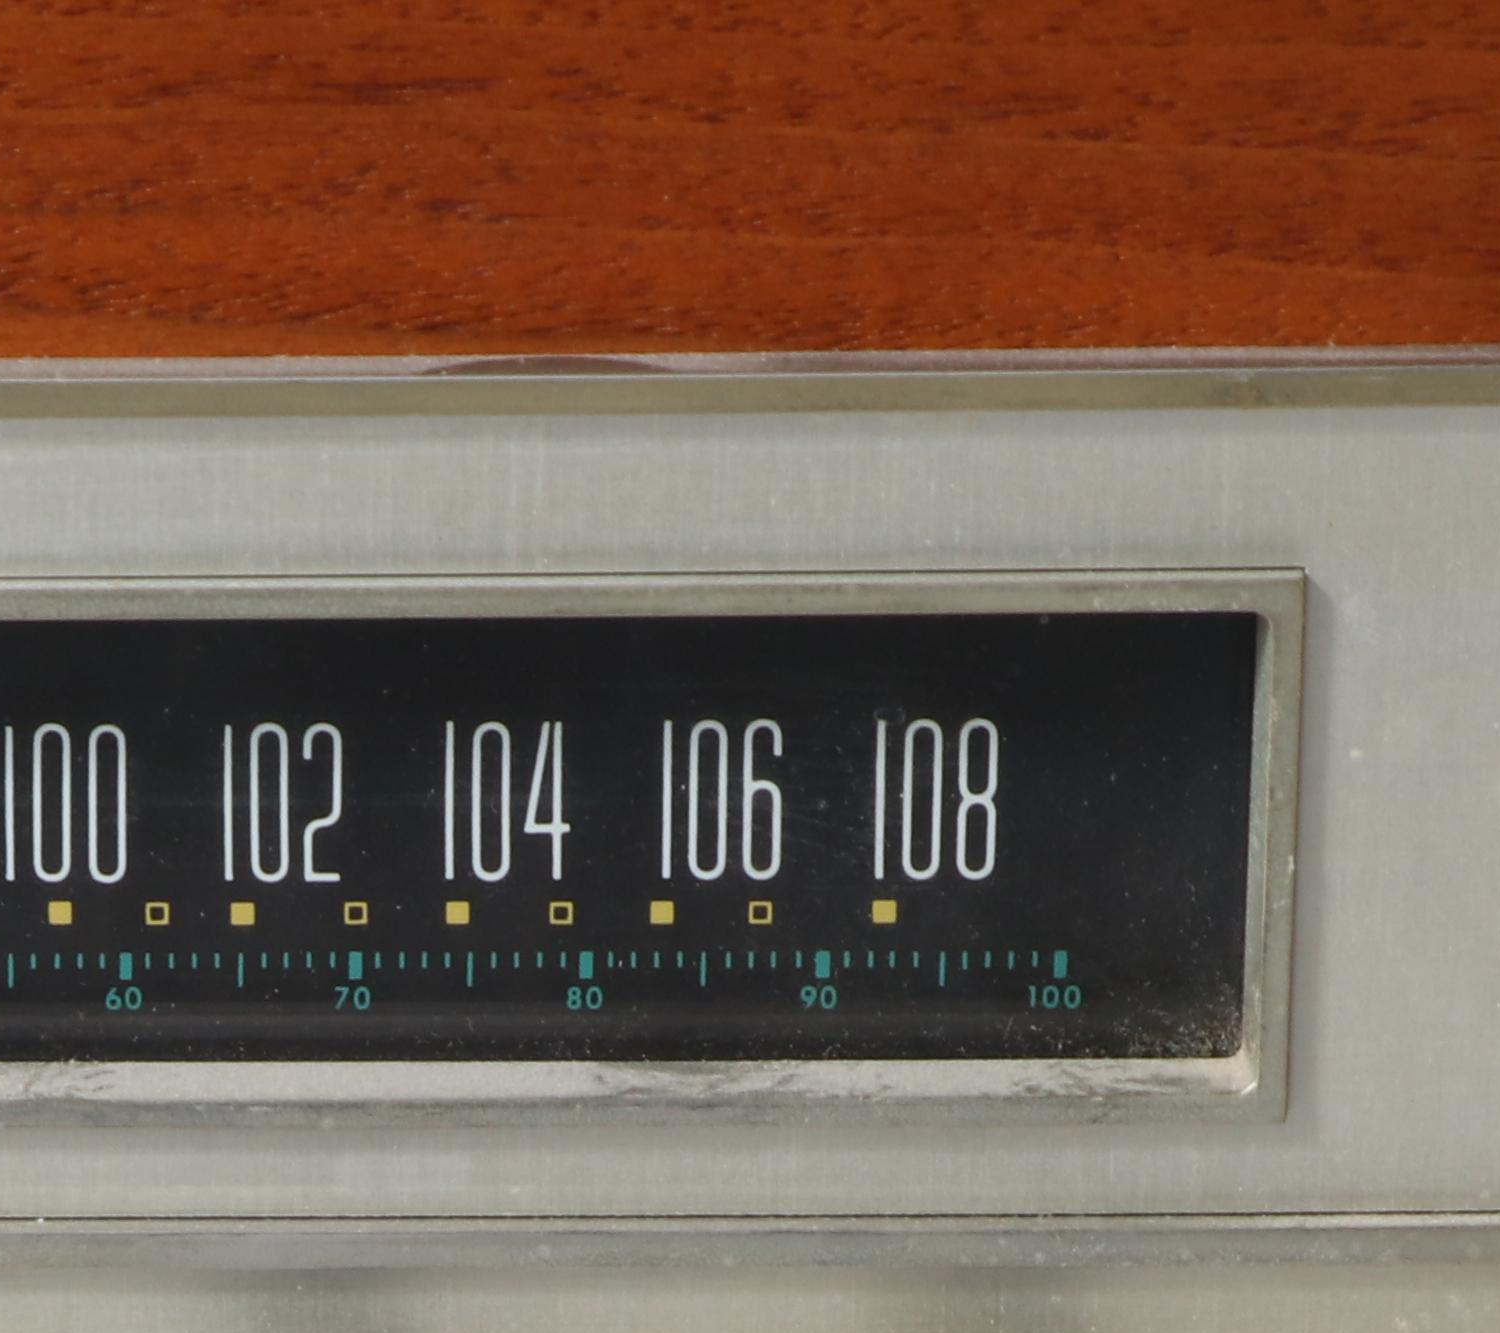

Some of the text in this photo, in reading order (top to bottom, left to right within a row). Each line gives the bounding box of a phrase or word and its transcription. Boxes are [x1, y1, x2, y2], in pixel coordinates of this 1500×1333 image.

[4, 723, 127, 884] 100
[223, 723, 342, 883] 102
[444, 721, 571, 882] 104
[661, 719, 783, 881] 106
[874, 718, 998, 881] 108
[105, 986, 142, 1011] 60
[334, 986, 371, 1011] 70
[566, 986, 603, 1010] 80
[800, 985, 837, 1010] 90
[1028, 985, 1081, 1009] 100
